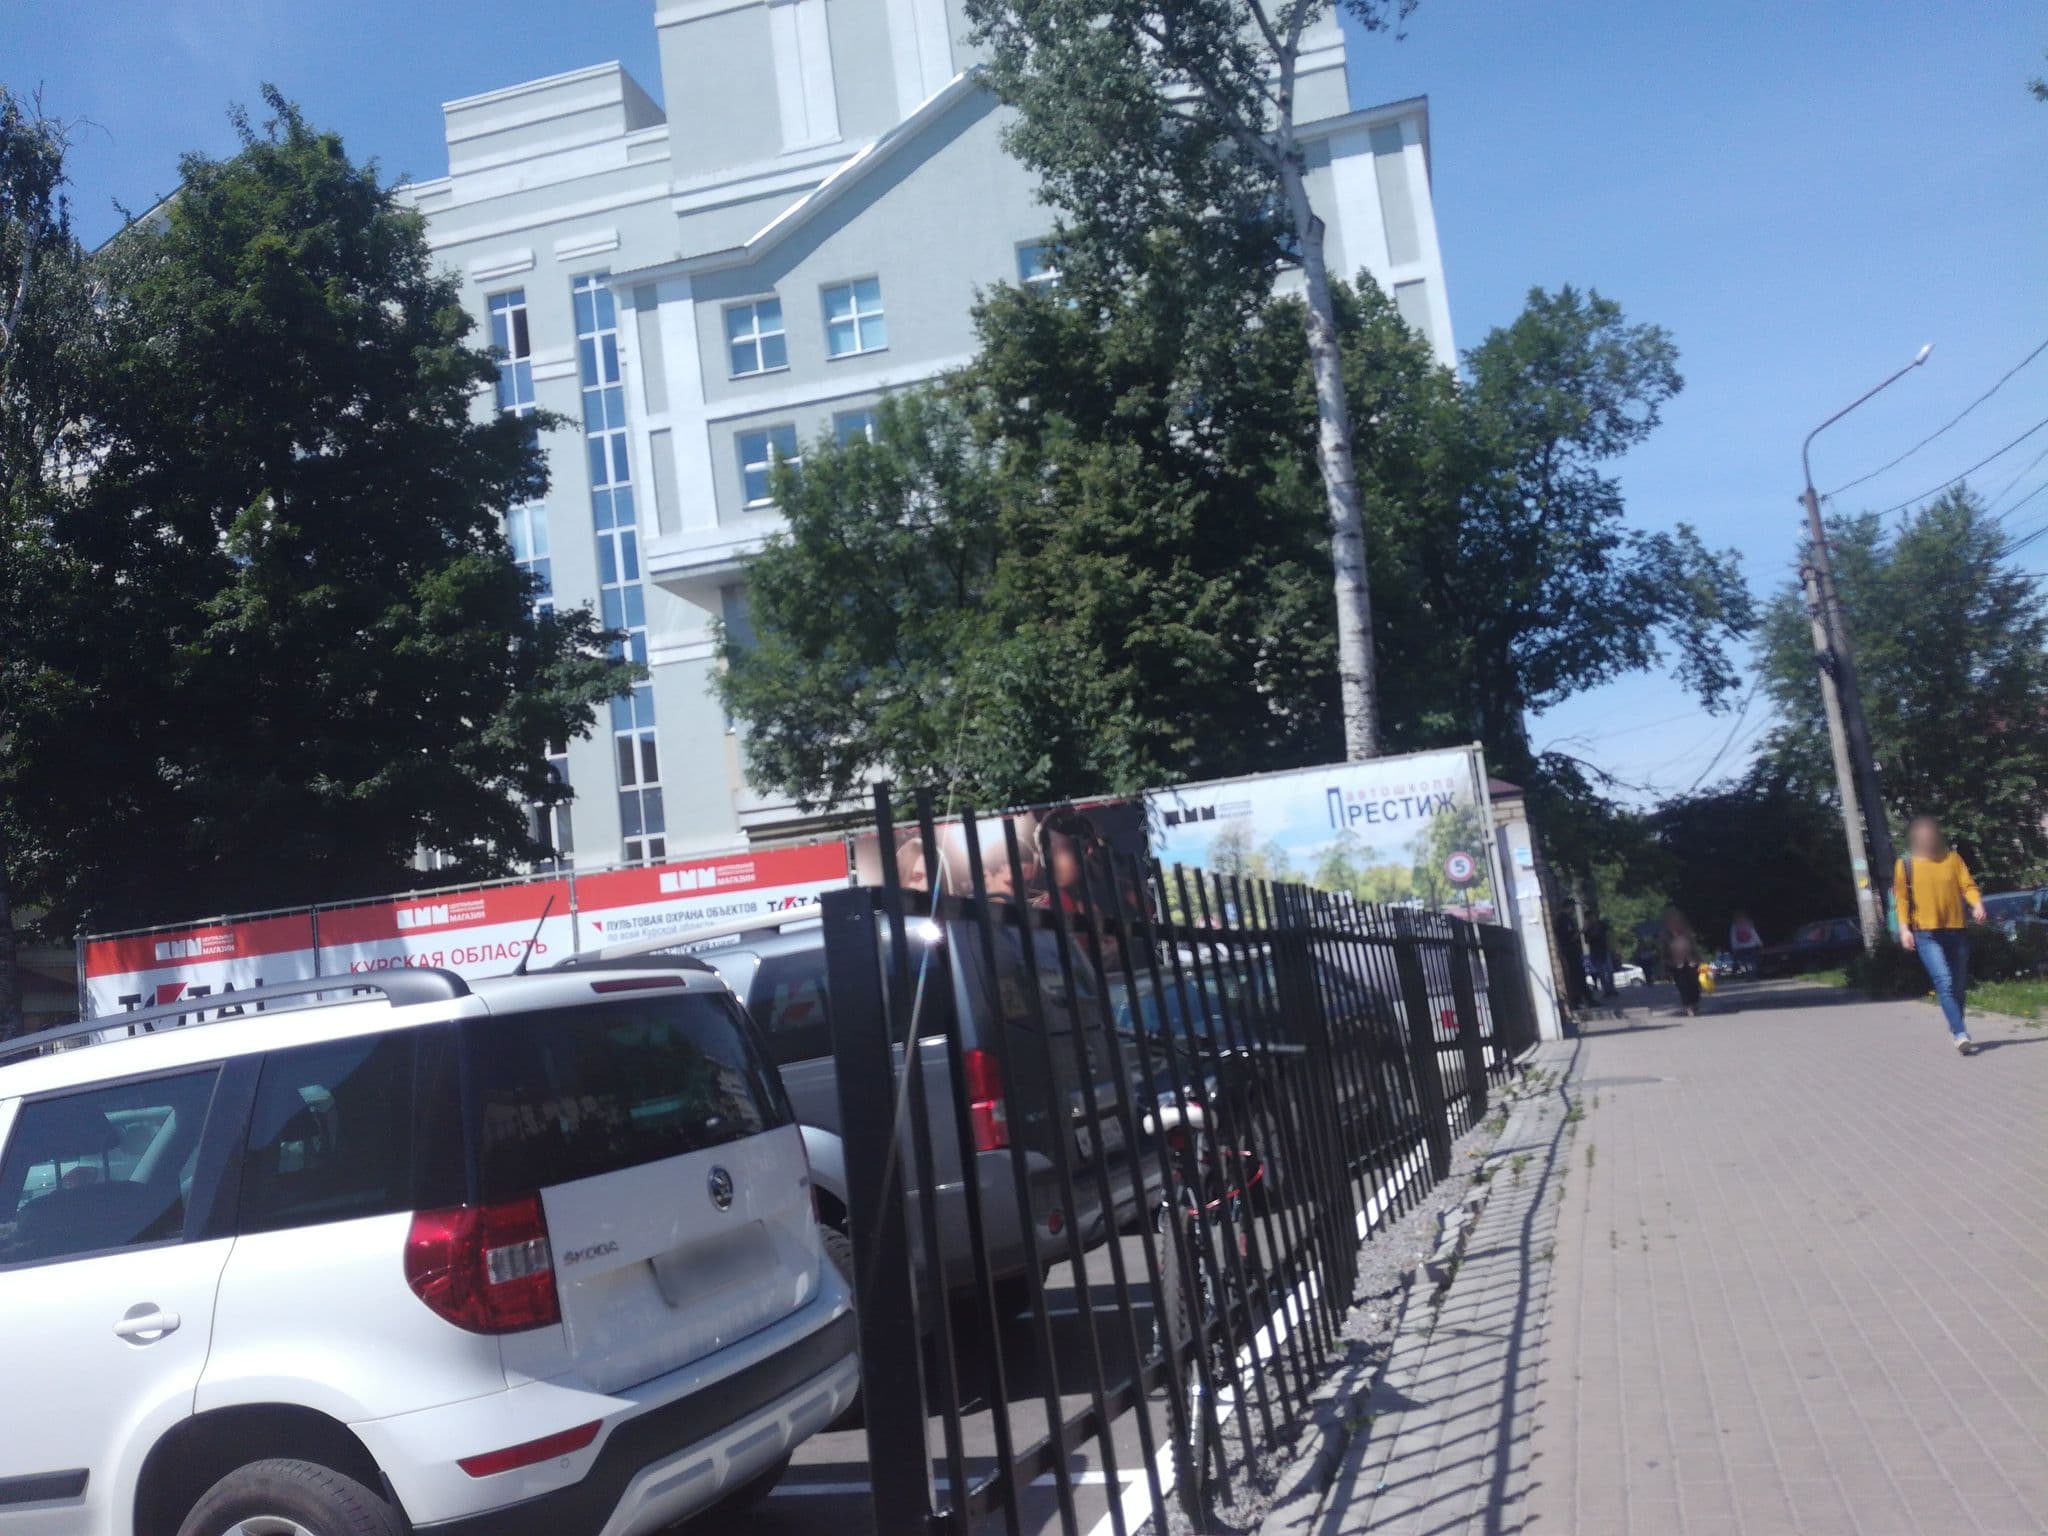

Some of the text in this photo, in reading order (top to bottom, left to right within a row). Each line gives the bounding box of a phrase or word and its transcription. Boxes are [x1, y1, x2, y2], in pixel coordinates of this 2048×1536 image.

[1326, 787, 1457, 828] ПРЕСТИЖ
[449, 911, 485, 922] МАГАЗИН
[606, 902, 758, 931] ПУЛЬТОВАЯ ОХРАНА ОБЪЕКТОВ
[202, 944, 235, 955] МАГАЗИН
[350, 938, 548, 975] КУРСКАЯ ОБЛАСТЬ
